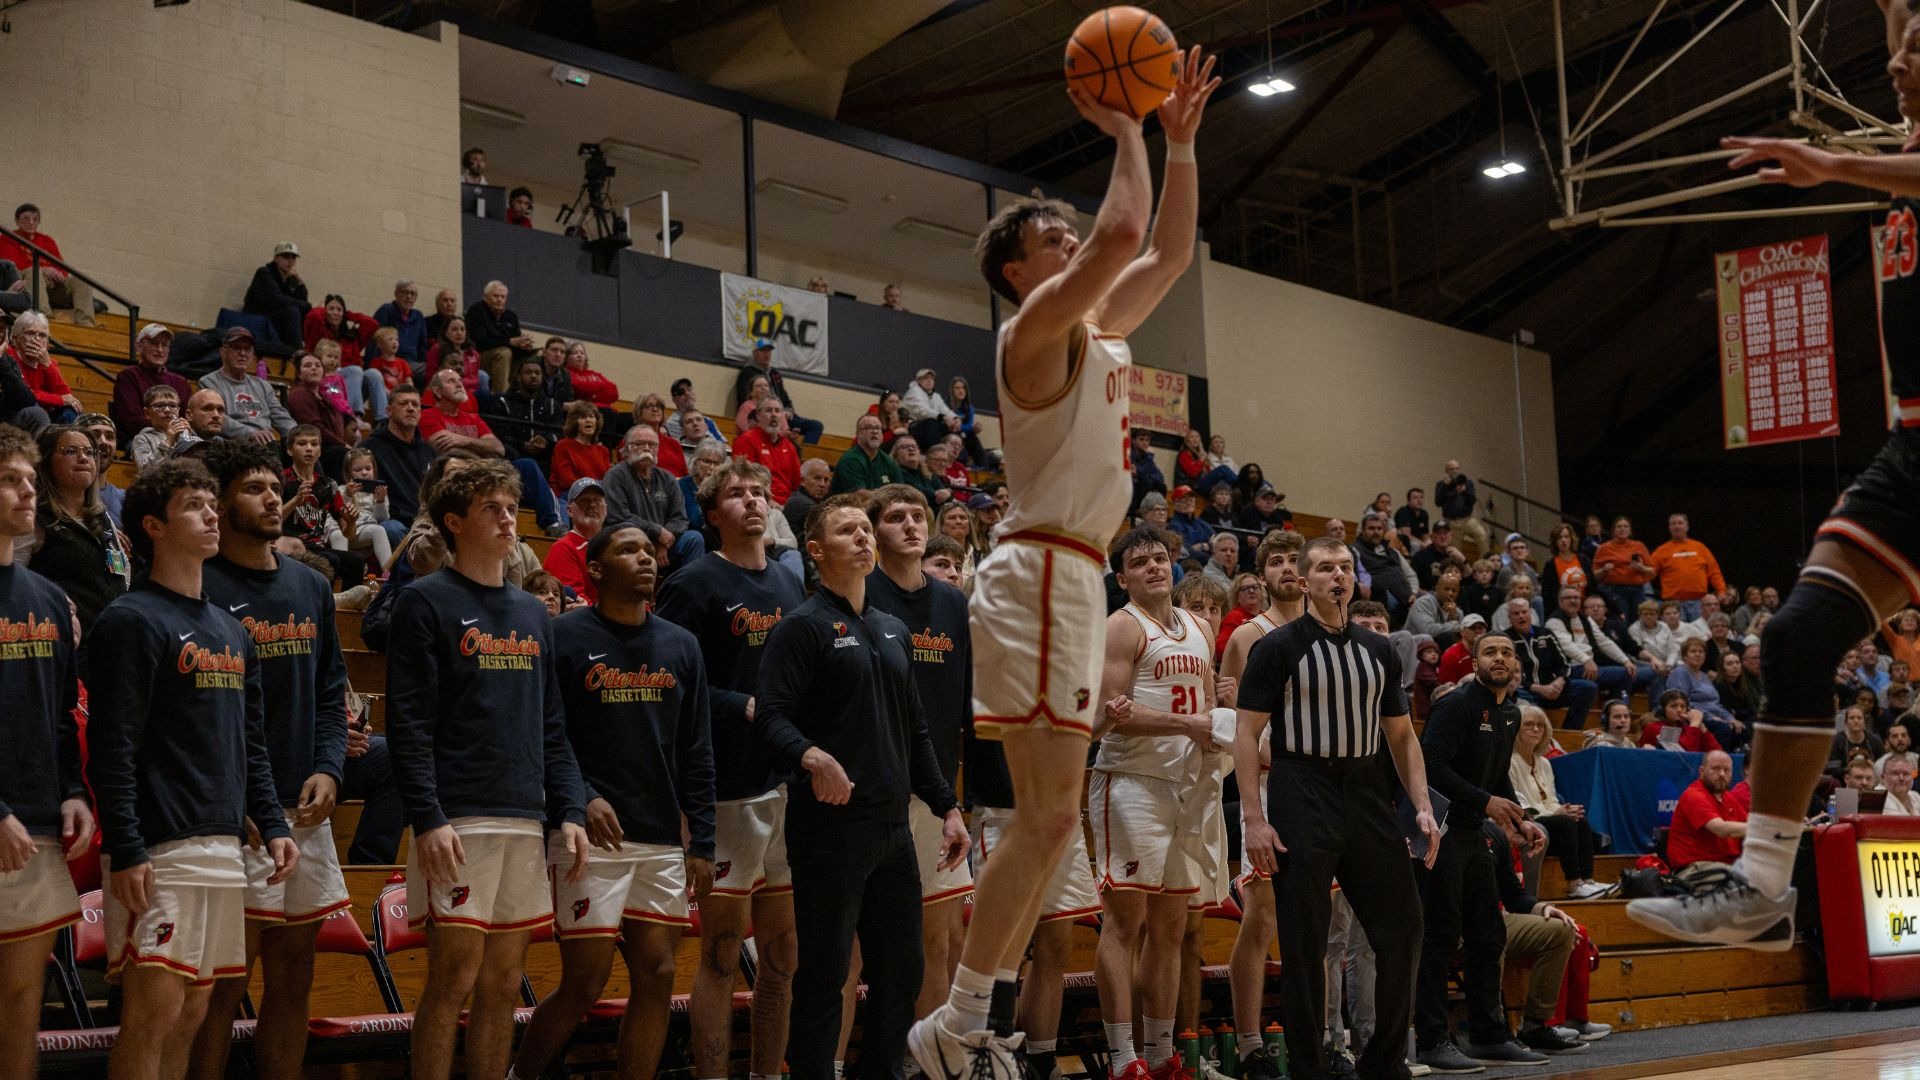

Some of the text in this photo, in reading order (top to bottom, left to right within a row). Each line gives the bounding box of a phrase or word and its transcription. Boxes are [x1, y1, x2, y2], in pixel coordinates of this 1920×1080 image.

[1759, 241, 1804, 264] OAC
[1740, 256, 1828, 288] CHAMPIONS
[752, 310, 818, 347] OAC
[1724, 314, 1740, 376] GOLF
[1155, 373, 1185, 395] 97.5
[459, 627, 541, 657] Otterbein
[477, 654, 534, 671] BASKETBALL
[584, 662, 677, 692] Otterbein
[601, 687, 663, 704] BASKETBALL
[1171, 685, 1197, 715] 21
[1892, 915, 1917, 936] OAC
